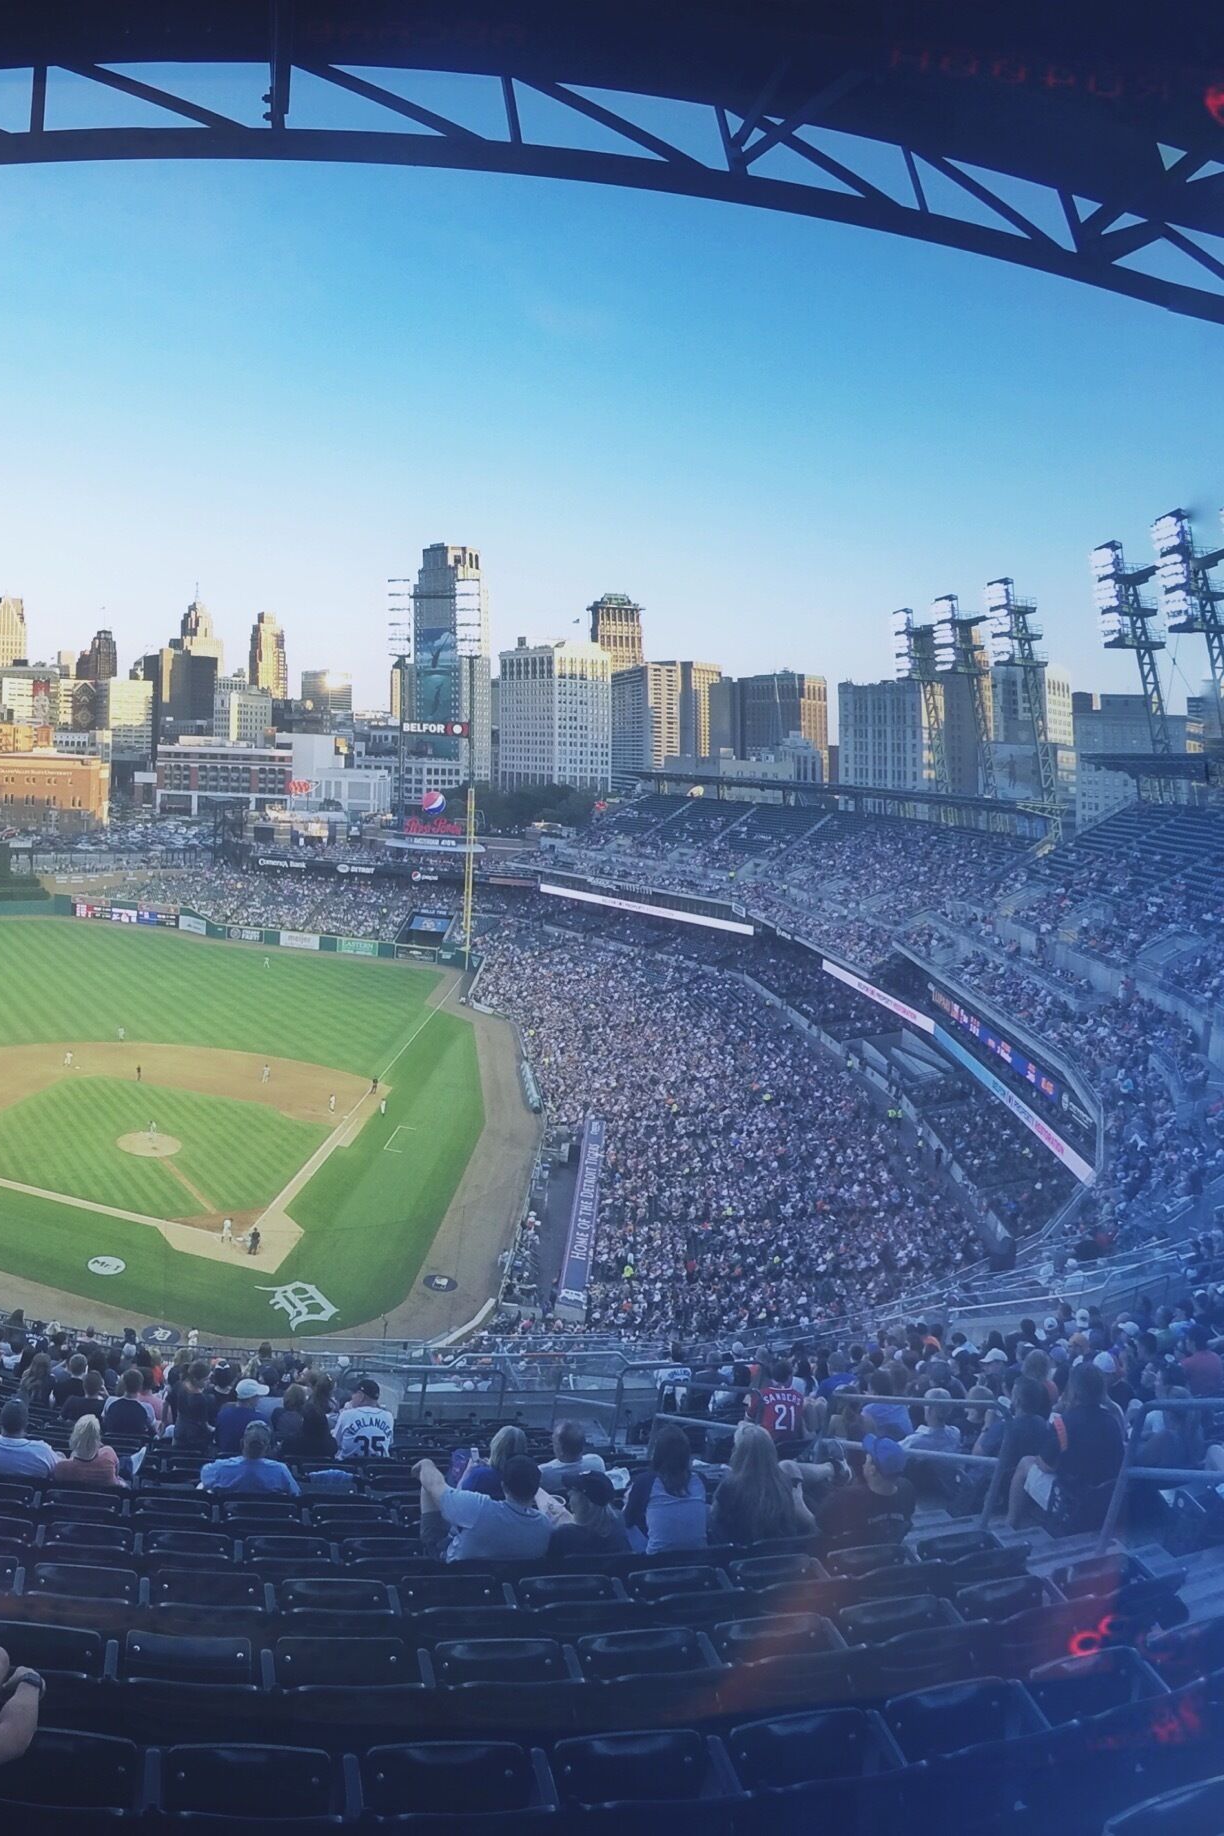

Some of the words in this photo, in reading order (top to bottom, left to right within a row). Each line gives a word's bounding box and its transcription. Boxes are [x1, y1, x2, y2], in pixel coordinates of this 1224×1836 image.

[402, 722, 445, 734] BELFOR
[342, 941, 373, 950] EASTERN
[585, 1144, 600, 1165] TIGERS
[580, 1167, 597, 1198] DETROIT
[579, 1200, 593, 1217] THE
[578, 1218, 592, 1230] OF
[571, 1232, 589, 1260] HOME
[774, 1404, 795, 1432] 21
[354, 1435, 385, 1456] 35
